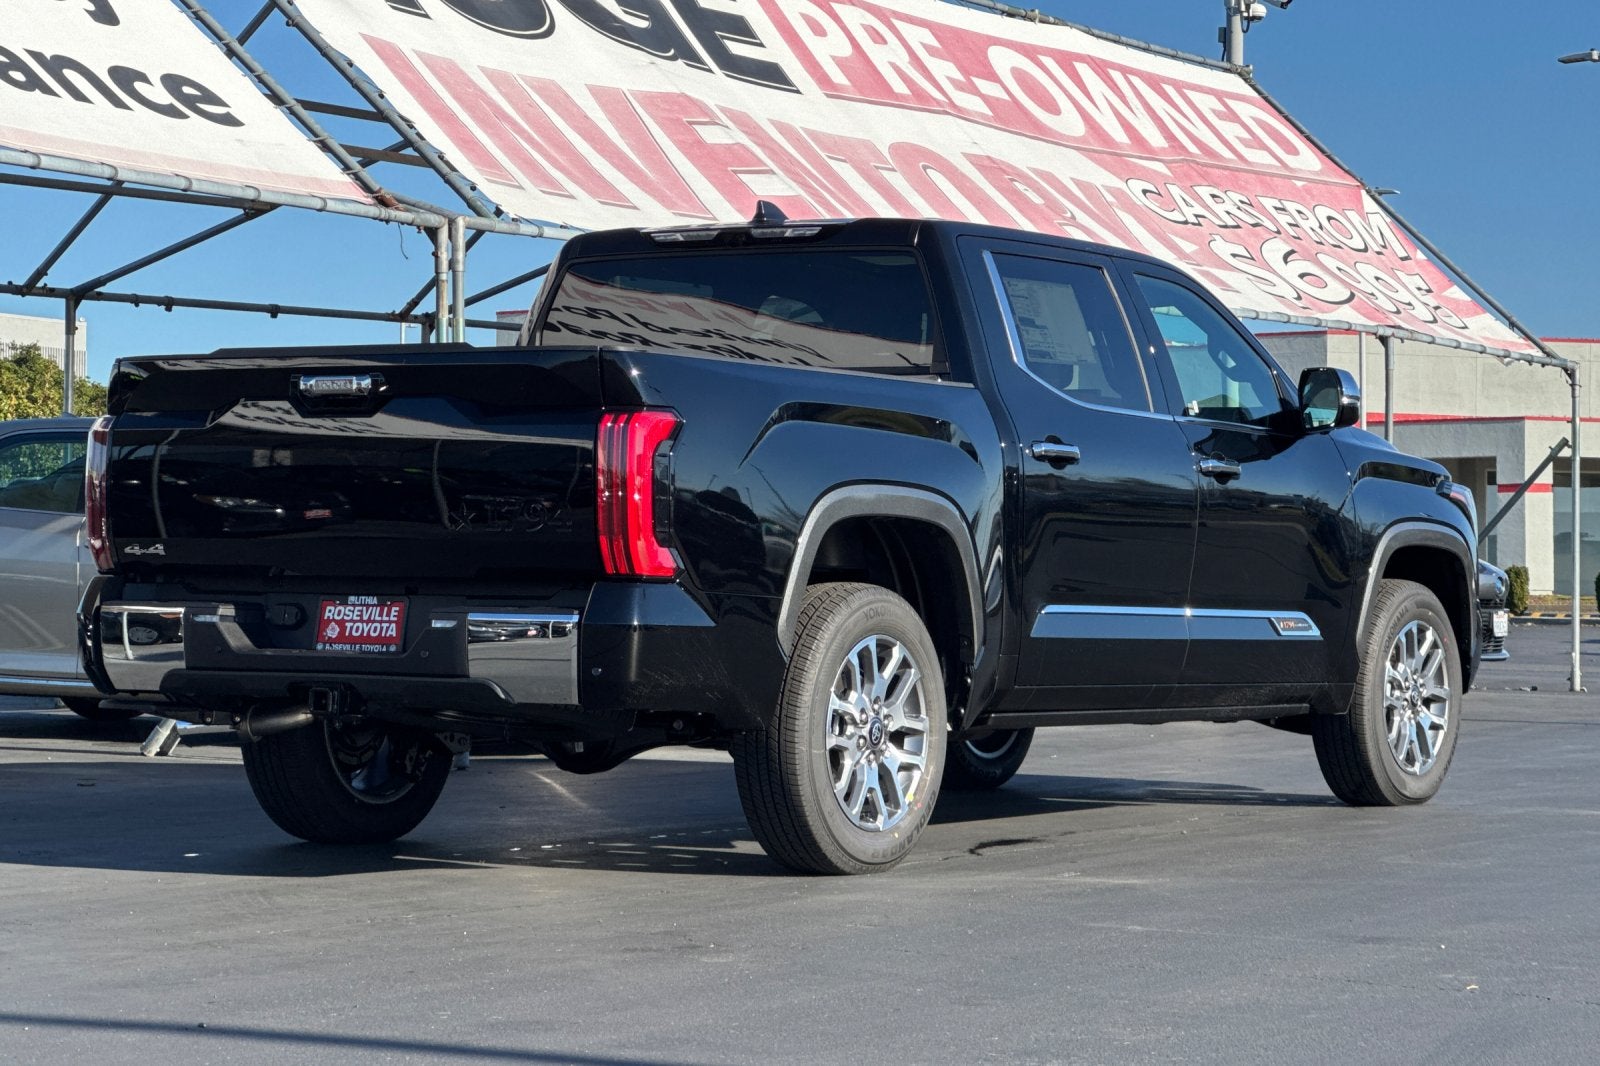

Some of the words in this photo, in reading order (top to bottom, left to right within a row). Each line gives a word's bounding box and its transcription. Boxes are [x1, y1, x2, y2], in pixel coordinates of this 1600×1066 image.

[774, 0, 1322, 172] PRE-OWNED
[1126, 178, 1281, 235] CARS
[1255, 194, 1412, 261] FROM
[1209, 232, 1469, 330] $6995
[355, 596, 378, 605] LITHIA
[323, 605, 400, 621] ROSEVILLE
[345, 622, 397, 637] TOYOTA
[361, 644, 387, 653] TOYOTA
